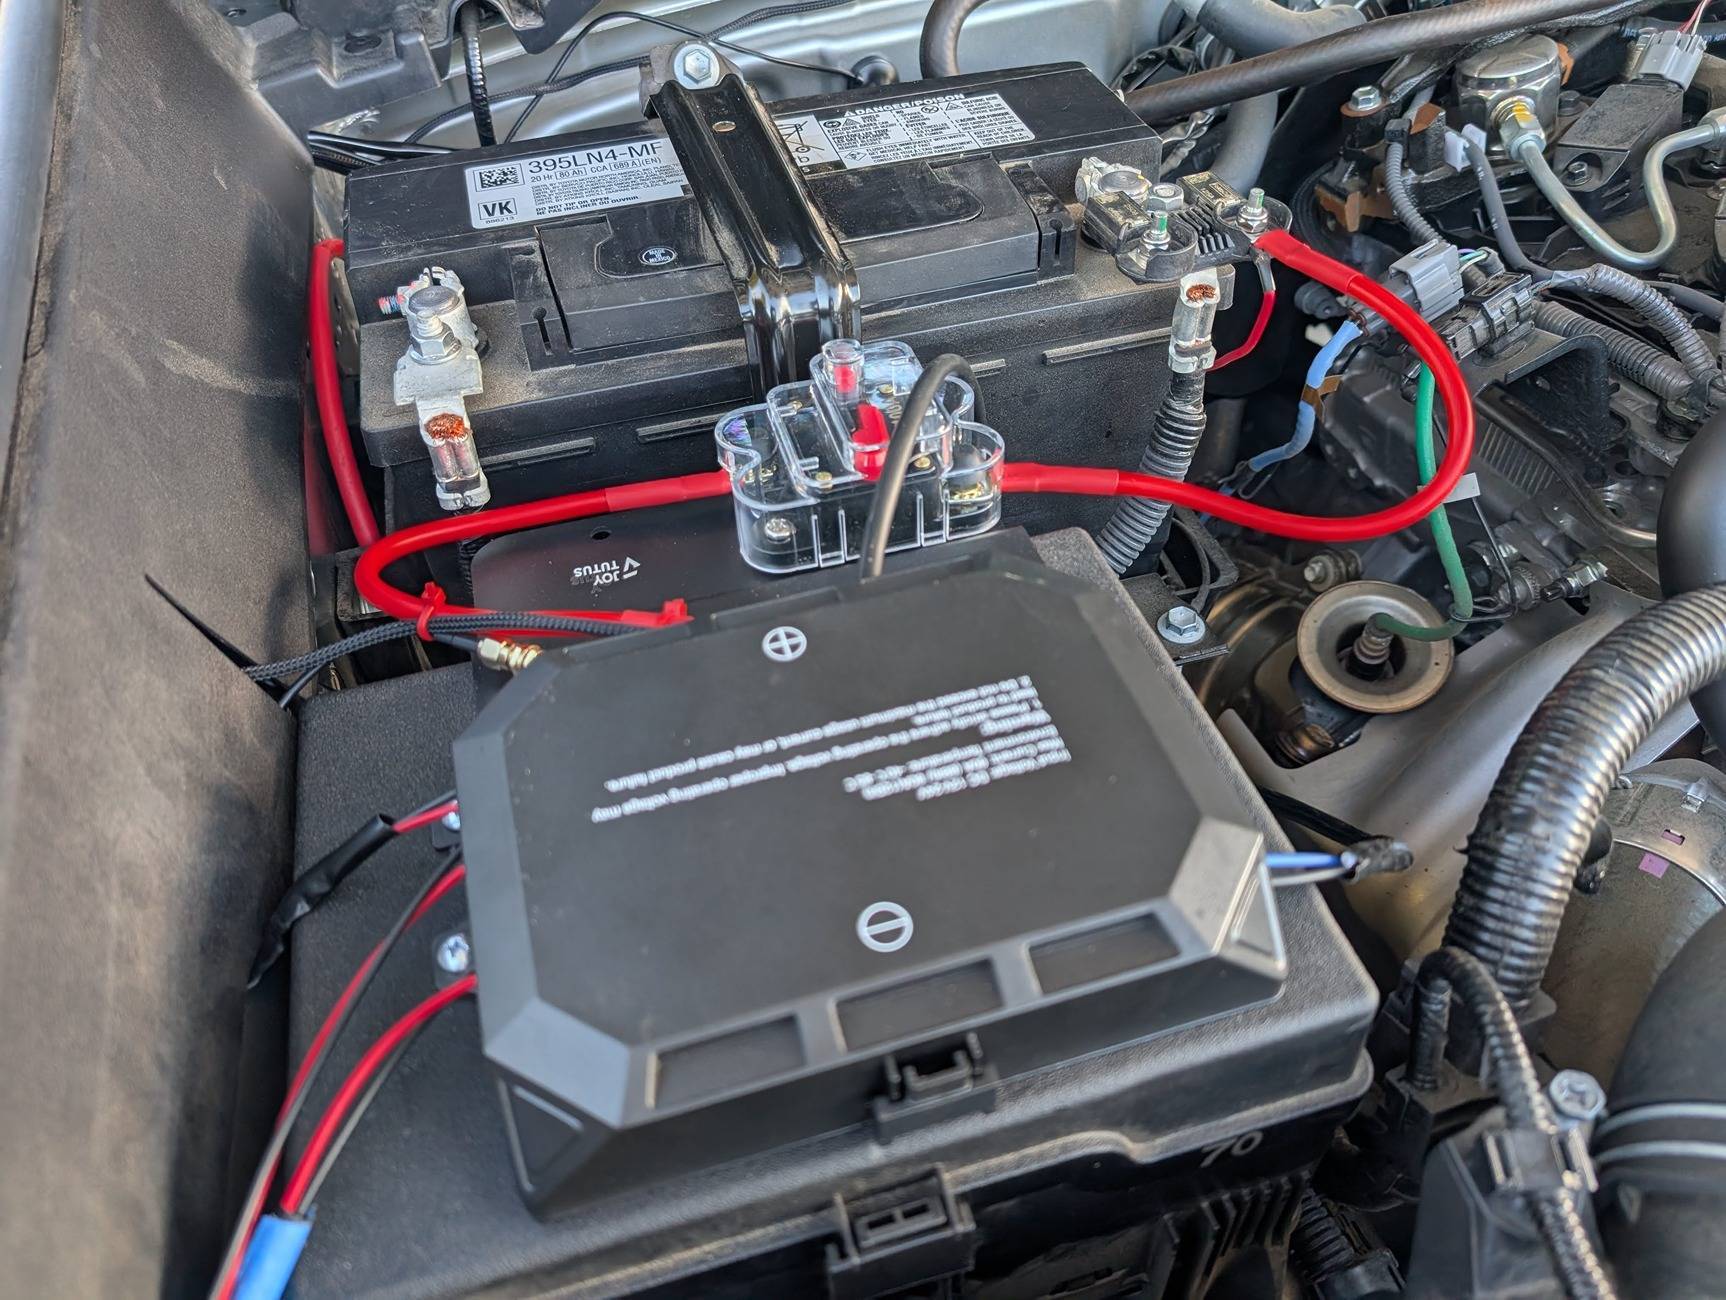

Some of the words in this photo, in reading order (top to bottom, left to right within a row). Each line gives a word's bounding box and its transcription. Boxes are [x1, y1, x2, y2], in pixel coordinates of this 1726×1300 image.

[855, 94, 965, 115] DANGER/POISON
[528, 141, 662, 174] 395LN4-MF
[590, 165, 608, 173] CCA
[640, 157, 661, 165] (EN)
[482, 200, 514, 217] VK
[573, 560, 620, 577] TUTUS
[593, 570, 620, 586] JOY
